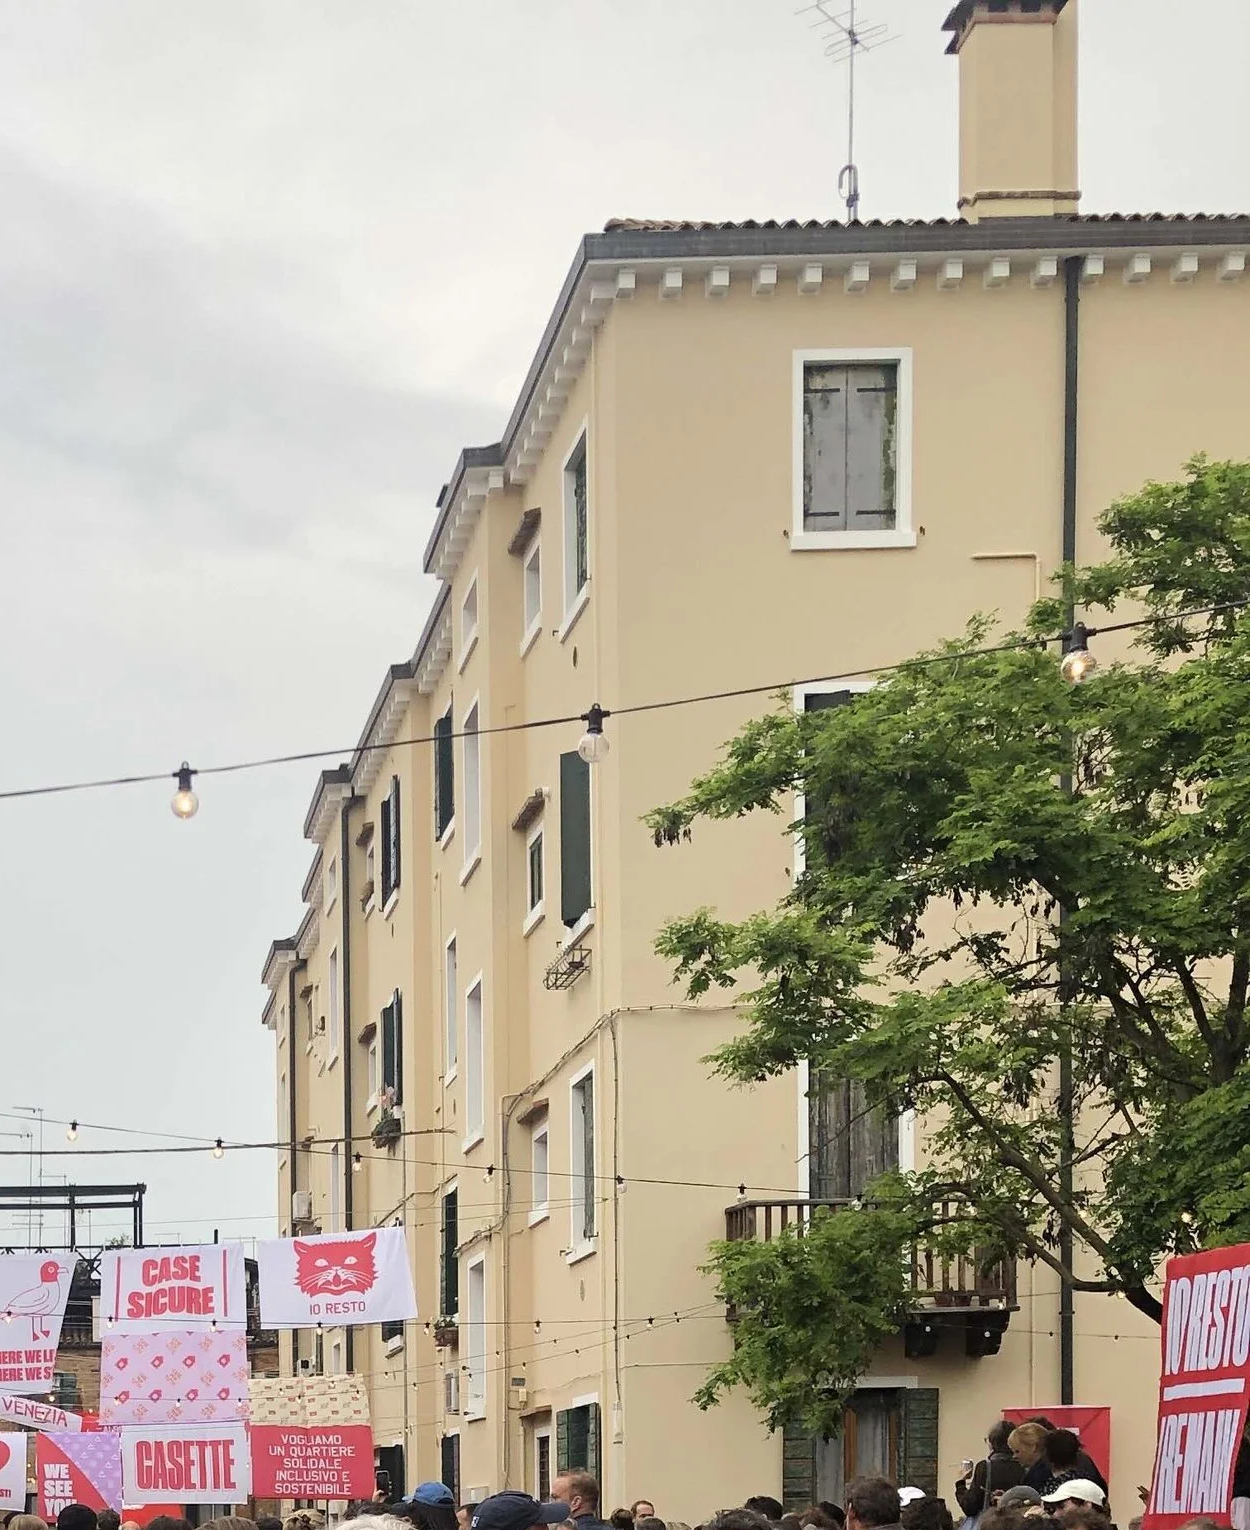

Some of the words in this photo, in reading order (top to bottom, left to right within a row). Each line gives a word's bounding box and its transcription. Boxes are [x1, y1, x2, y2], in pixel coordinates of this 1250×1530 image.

[141, 1255, 201, 1287] CASE
[127, 1286, 214, 1318] SICURE
[310, 1304, 321, 1315] IO
[326, 1301, 366, 1314] RESTO
[1164, 1277, 1192, 1375] IO
[1183, 1264, 1250, 1372] RESTO
[24, 1350, 42, 1363] WE
[24, 1367, 43, 1381] WE
[2, 1396, 68, 1427] VENEZIA
[281, 1434, 342, 1446] VOGLIAMO
[269, 1445, 285, 1456] UN
[290, 1446, 355, 1458] QUARTIERE
[136, 1439, 236, 1490] CASETTE
[283, 1458, 342, 1469] SOLIDALE
[1156, 1409, 1241, 1515] REMAIN
[44, 1463, 70, 1479] WE
[276, 1470, 338, 1482] INCLUSIVO
[342, 1471, 350, 1482] E
[44, 1480, 74, 1497] SEE
[275, 1483, 352, 1495] SOSTENIBILE
[44, 1498, 78, 1517] YO
